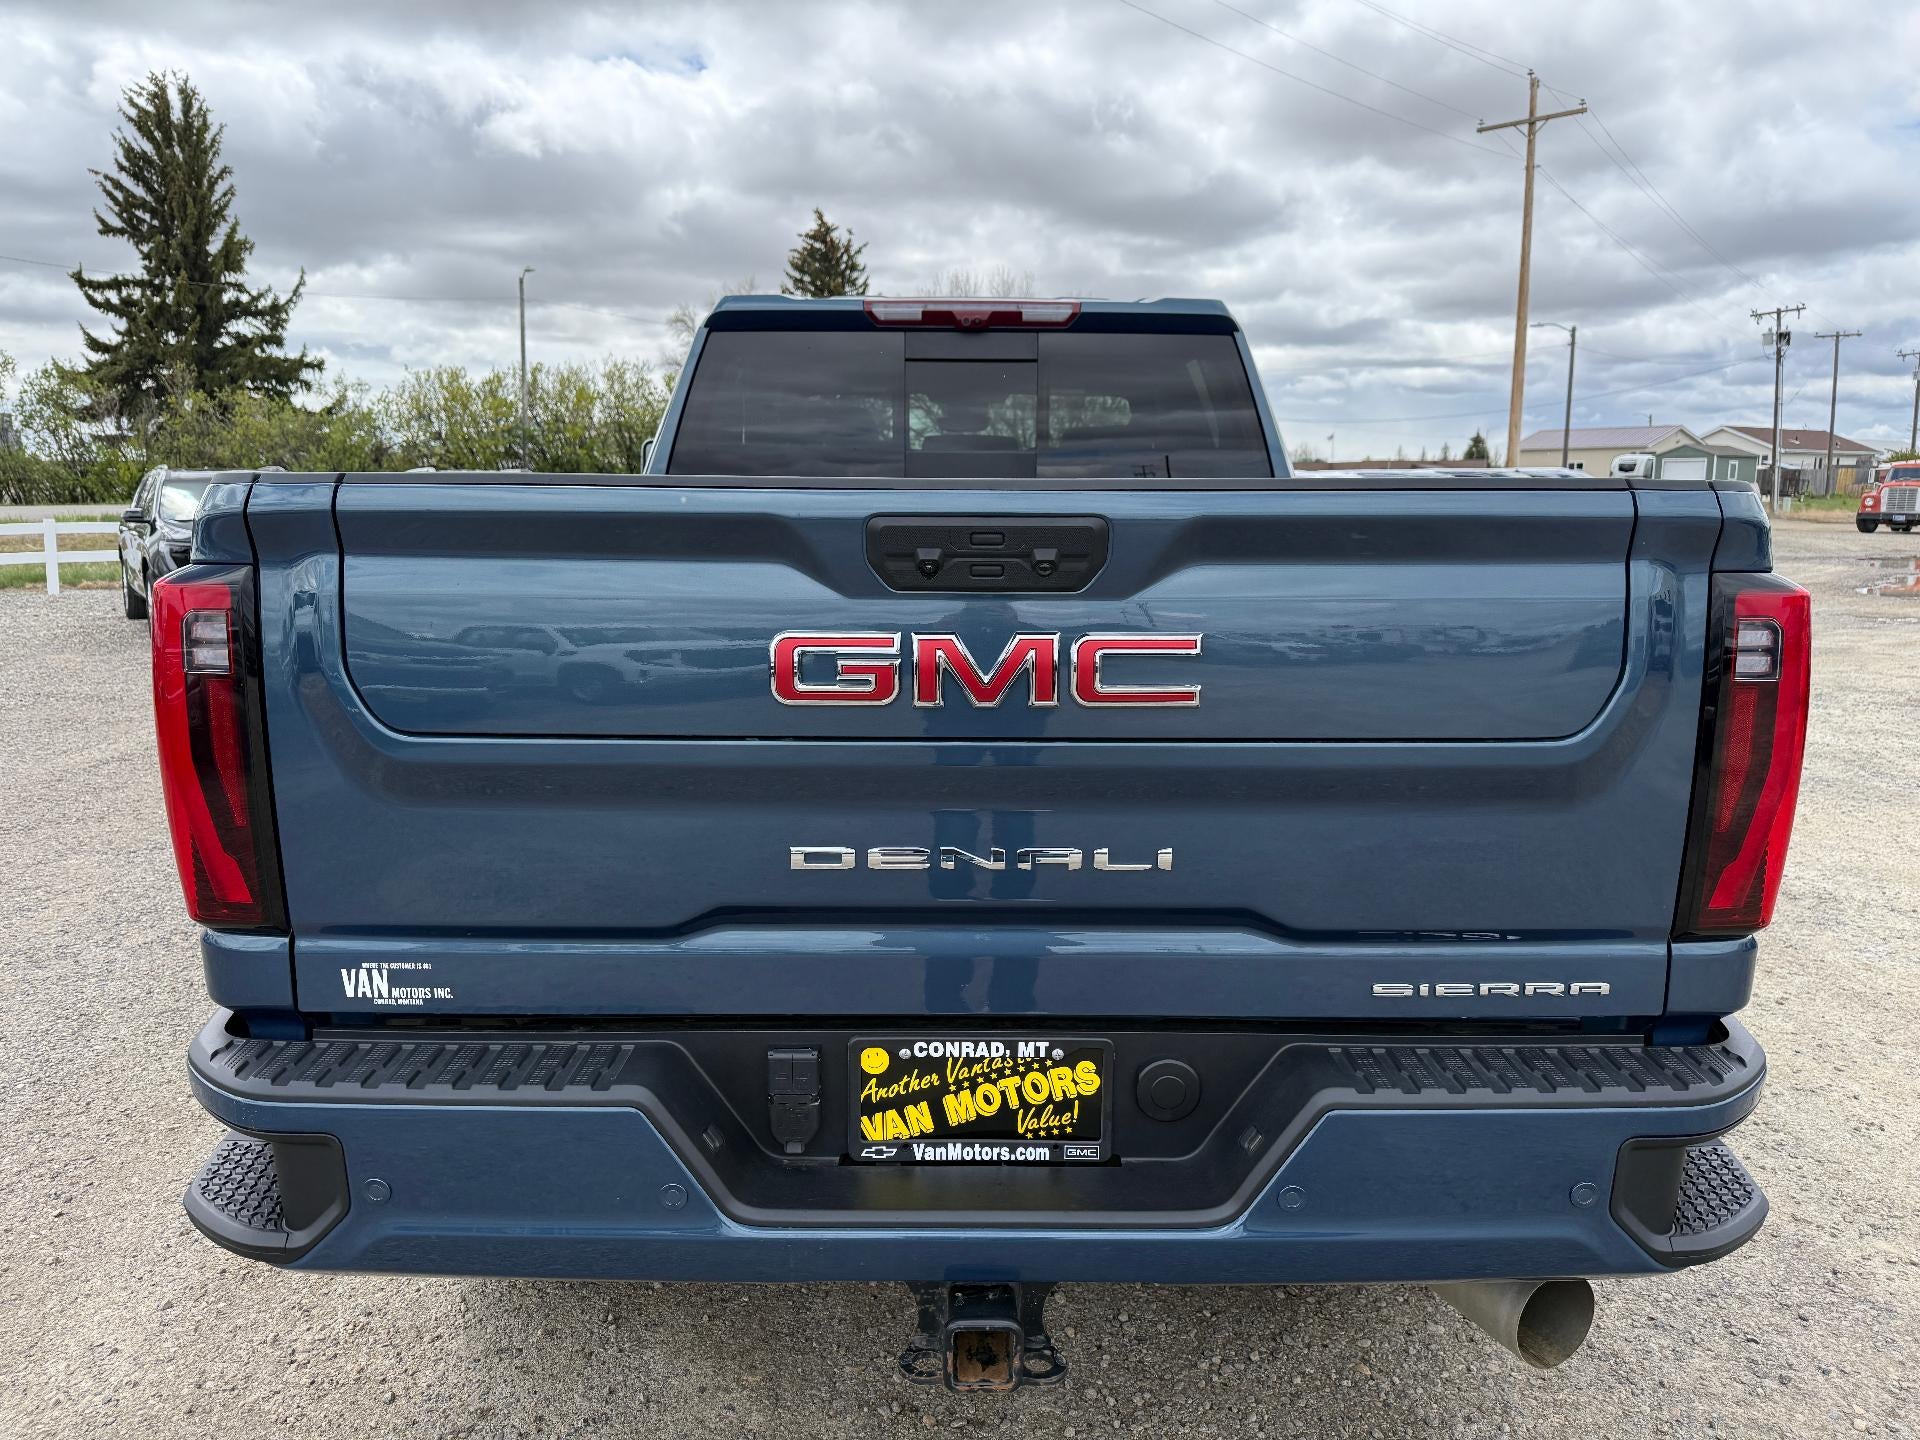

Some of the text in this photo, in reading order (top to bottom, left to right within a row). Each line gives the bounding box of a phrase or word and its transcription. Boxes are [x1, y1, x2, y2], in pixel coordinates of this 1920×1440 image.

[769, 630, 1203, 707] GMC
[790, 846, 1173, 870] DENALI
[340, 968, 454, 999] VAN MOTORS INC.
[1371, 982, 1611, 997] SIERRA
[913, 1041, 1050, 1058] CONRAD, MT
[860, 1056, 1040, 1104] Another Vantas
[860, 1060, 1102, 1142] VAN MOTORS
[1016, 1100, 1080, 1135] Value!
[912, 1143, 1050, 1161] VanMotors.com
[1066, 1148, 1098, 1158] GMC
